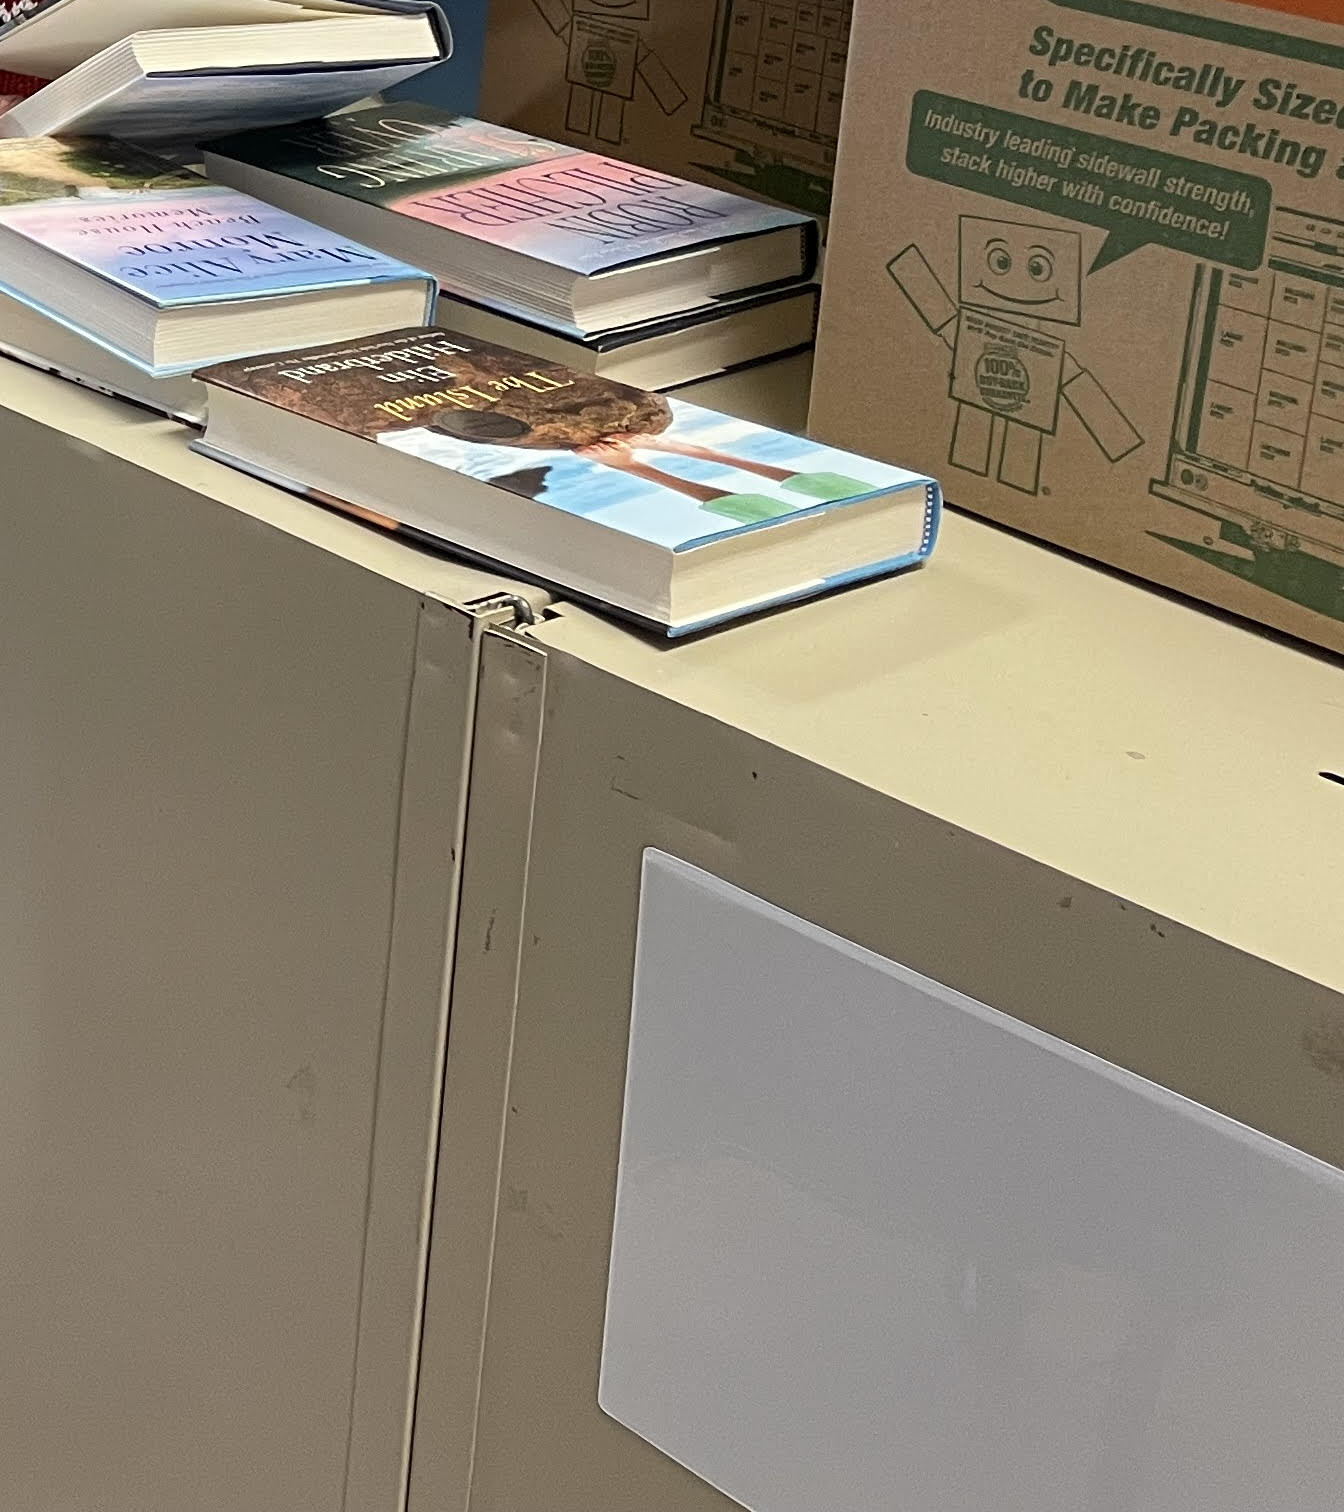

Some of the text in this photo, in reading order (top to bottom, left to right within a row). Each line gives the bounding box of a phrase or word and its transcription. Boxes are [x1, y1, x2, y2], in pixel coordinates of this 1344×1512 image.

[1029, 25, 1246, 108] Specifically
[1018, 69, 1327, 179] to Make Packing
[925, 109, 1255, 217] Industry leading sidewall strength,
[72, 206, 211, 227] Memories
[412, 163, 686, 228] PILCHER
[940, 146, 1230, 240] stack higher with confidence!
[79, 214, 260, 237] Beach House
[117, 230, 297, 257] Monroe
[544, 197, 720, 246] ROBIN
[119, 244, 378, 281] Mary Alice
[278, 340, 472, 385] Hilderbrand
[379, 368, 457, 386] Elin
[374, 369, 577, 422] The Island
